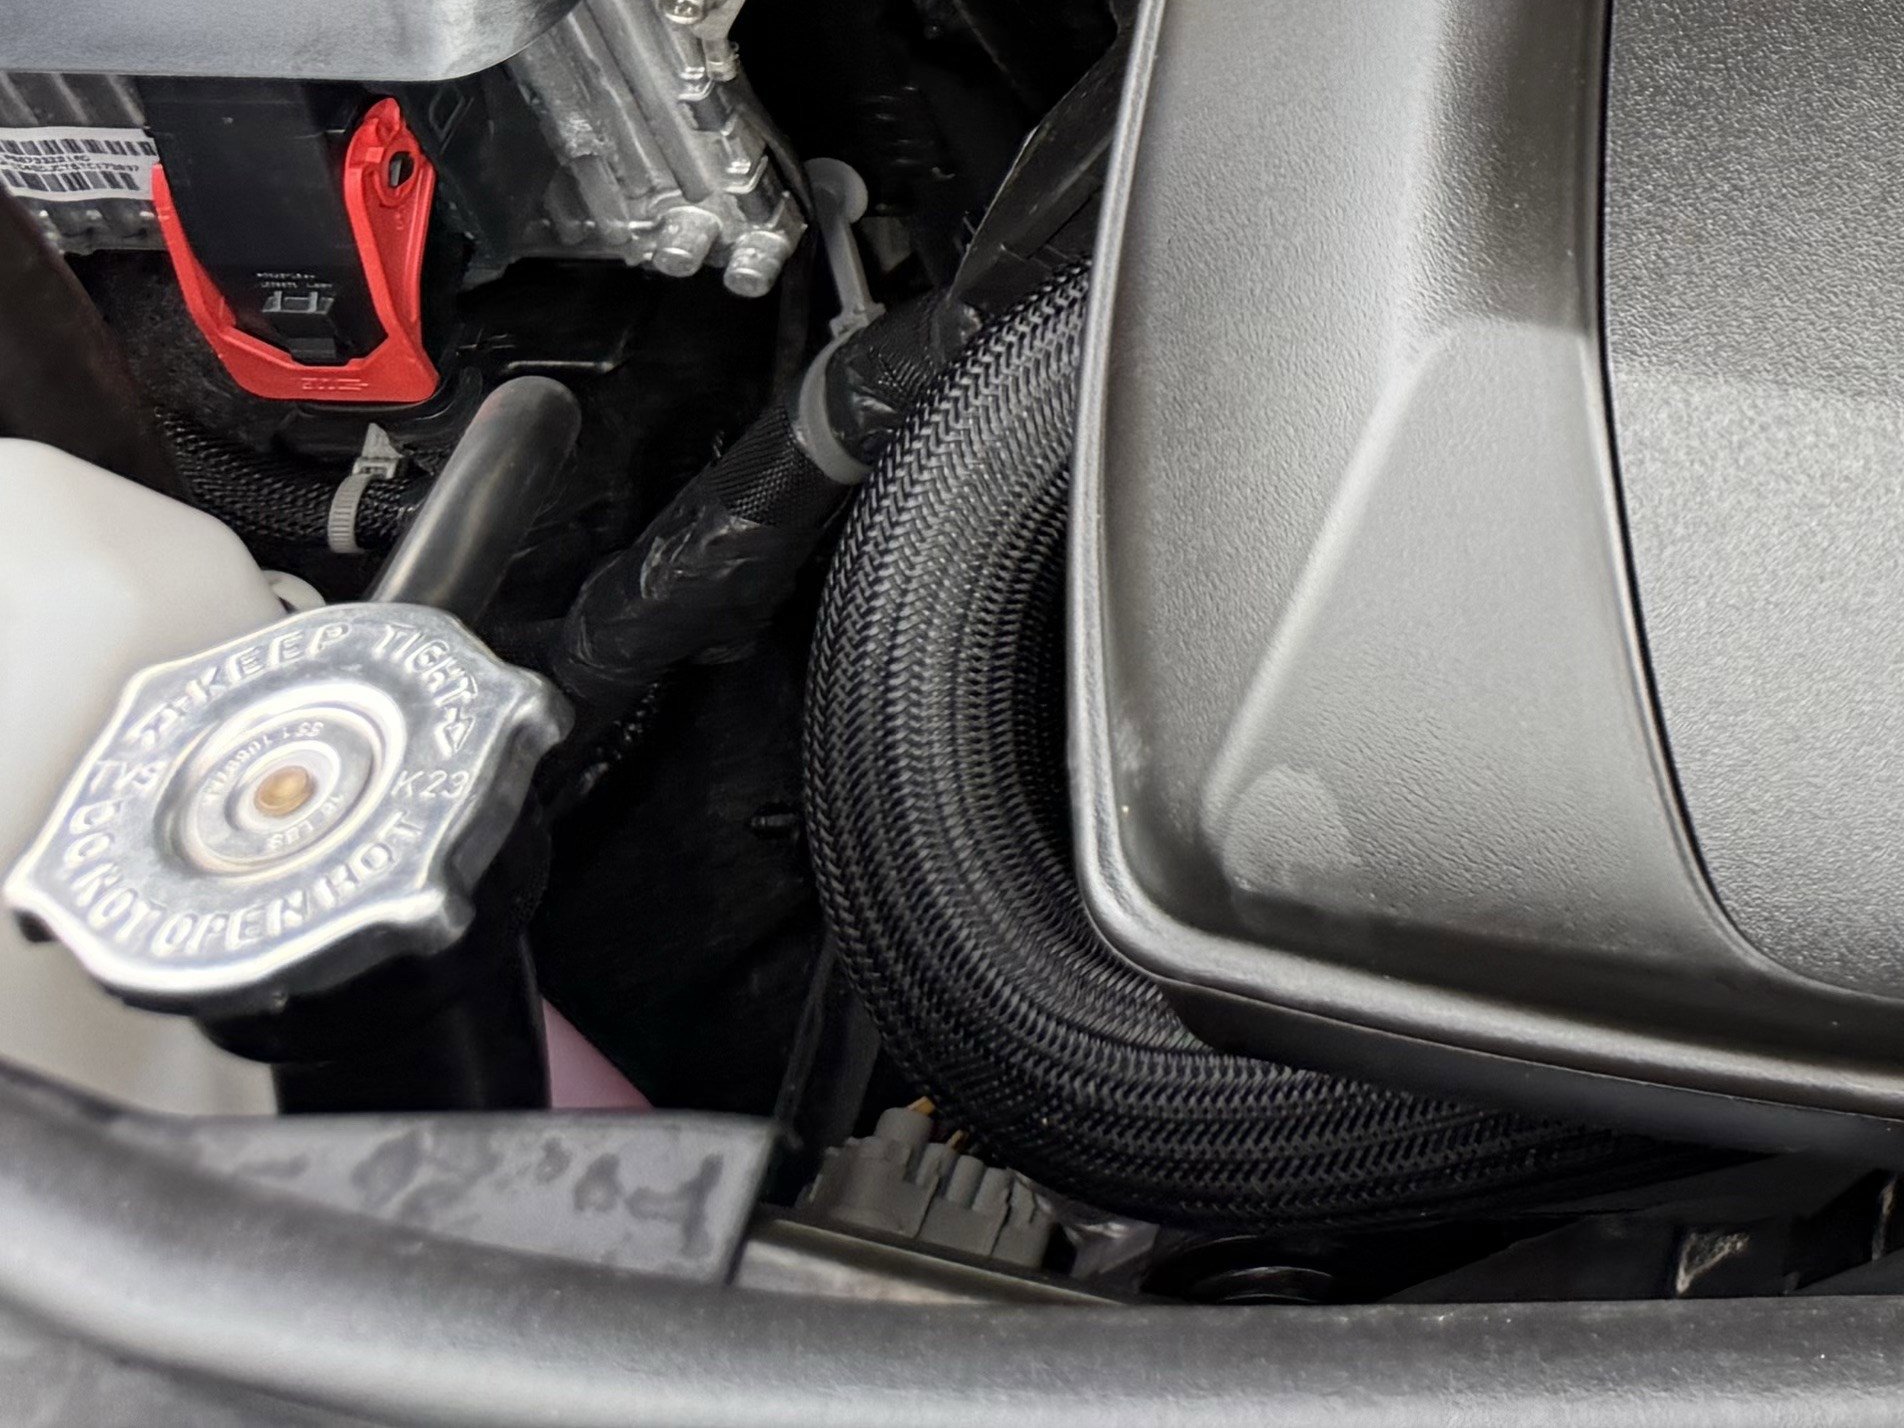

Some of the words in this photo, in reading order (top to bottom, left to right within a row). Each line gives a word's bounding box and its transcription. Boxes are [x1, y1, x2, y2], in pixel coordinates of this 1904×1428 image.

[188, 621, 351, 697] KEEP
[372, 624, 479, 708] TIGHT
[64, 798, 123, 868] DO
[317, 810, 426, 910] HOT
[68, 863, 168, 943] NOT
[150, 890, 313, 957] OPEN
